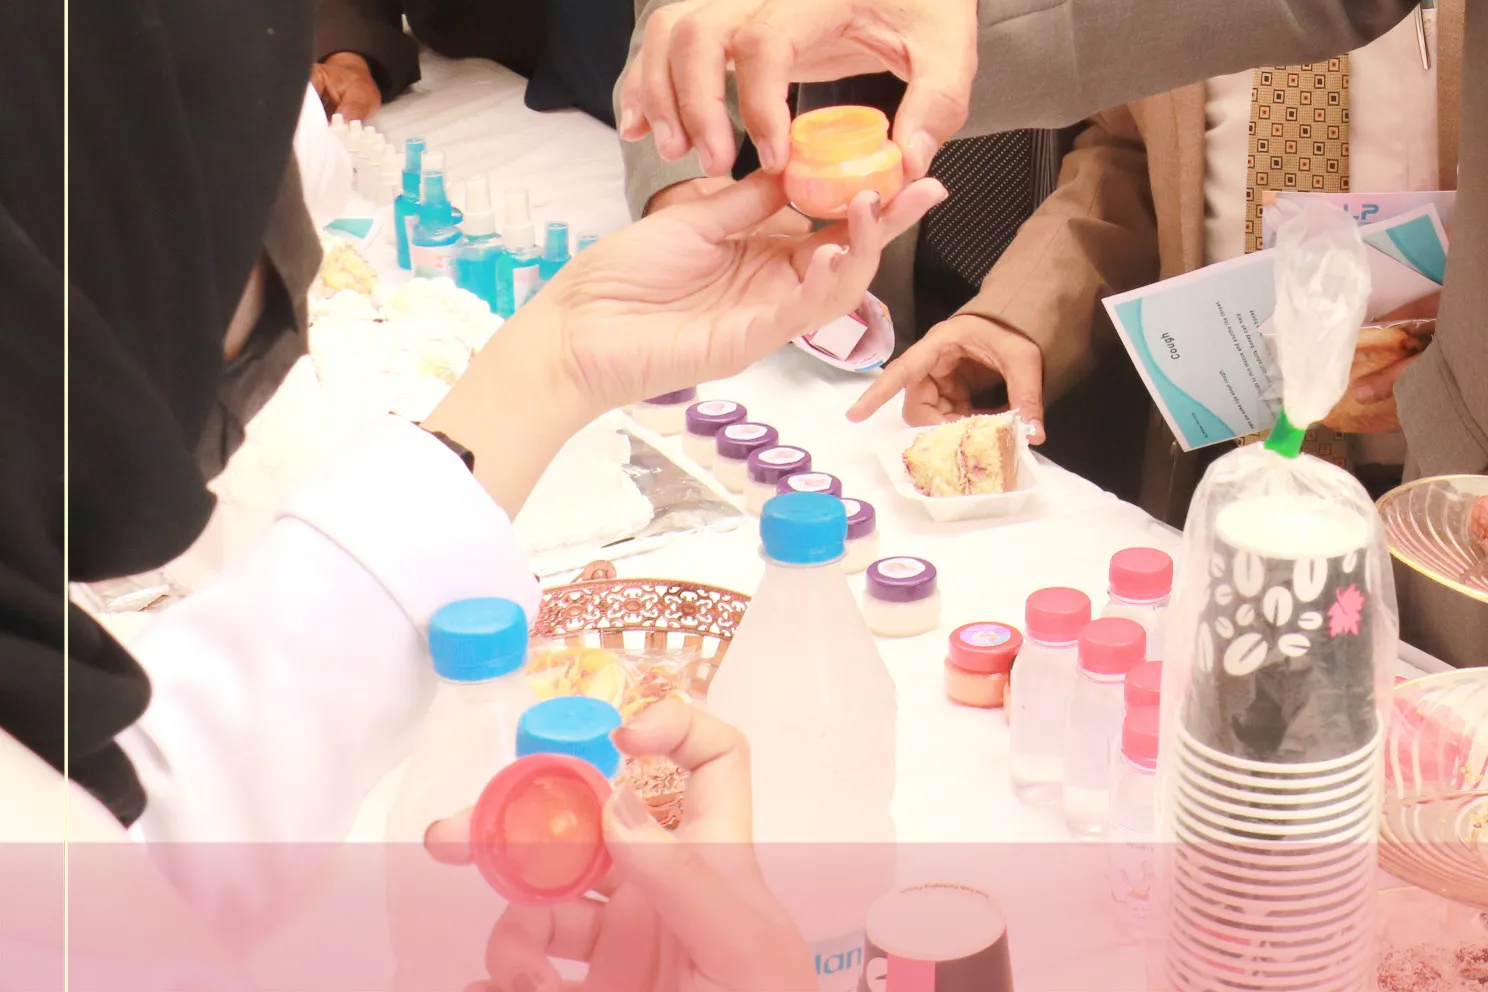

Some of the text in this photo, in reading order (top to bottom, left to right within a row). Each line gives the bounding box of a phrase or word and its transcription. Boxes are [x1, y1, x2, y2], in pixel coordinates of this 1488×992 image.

[1222, 317, 1230, 326] the
[1241, 324, 1249, 334] can
[1160, 332, 1180, 360] Cough
[1245, 333, 1255, 349] honey
[1225, 383, 1236, 396] about
